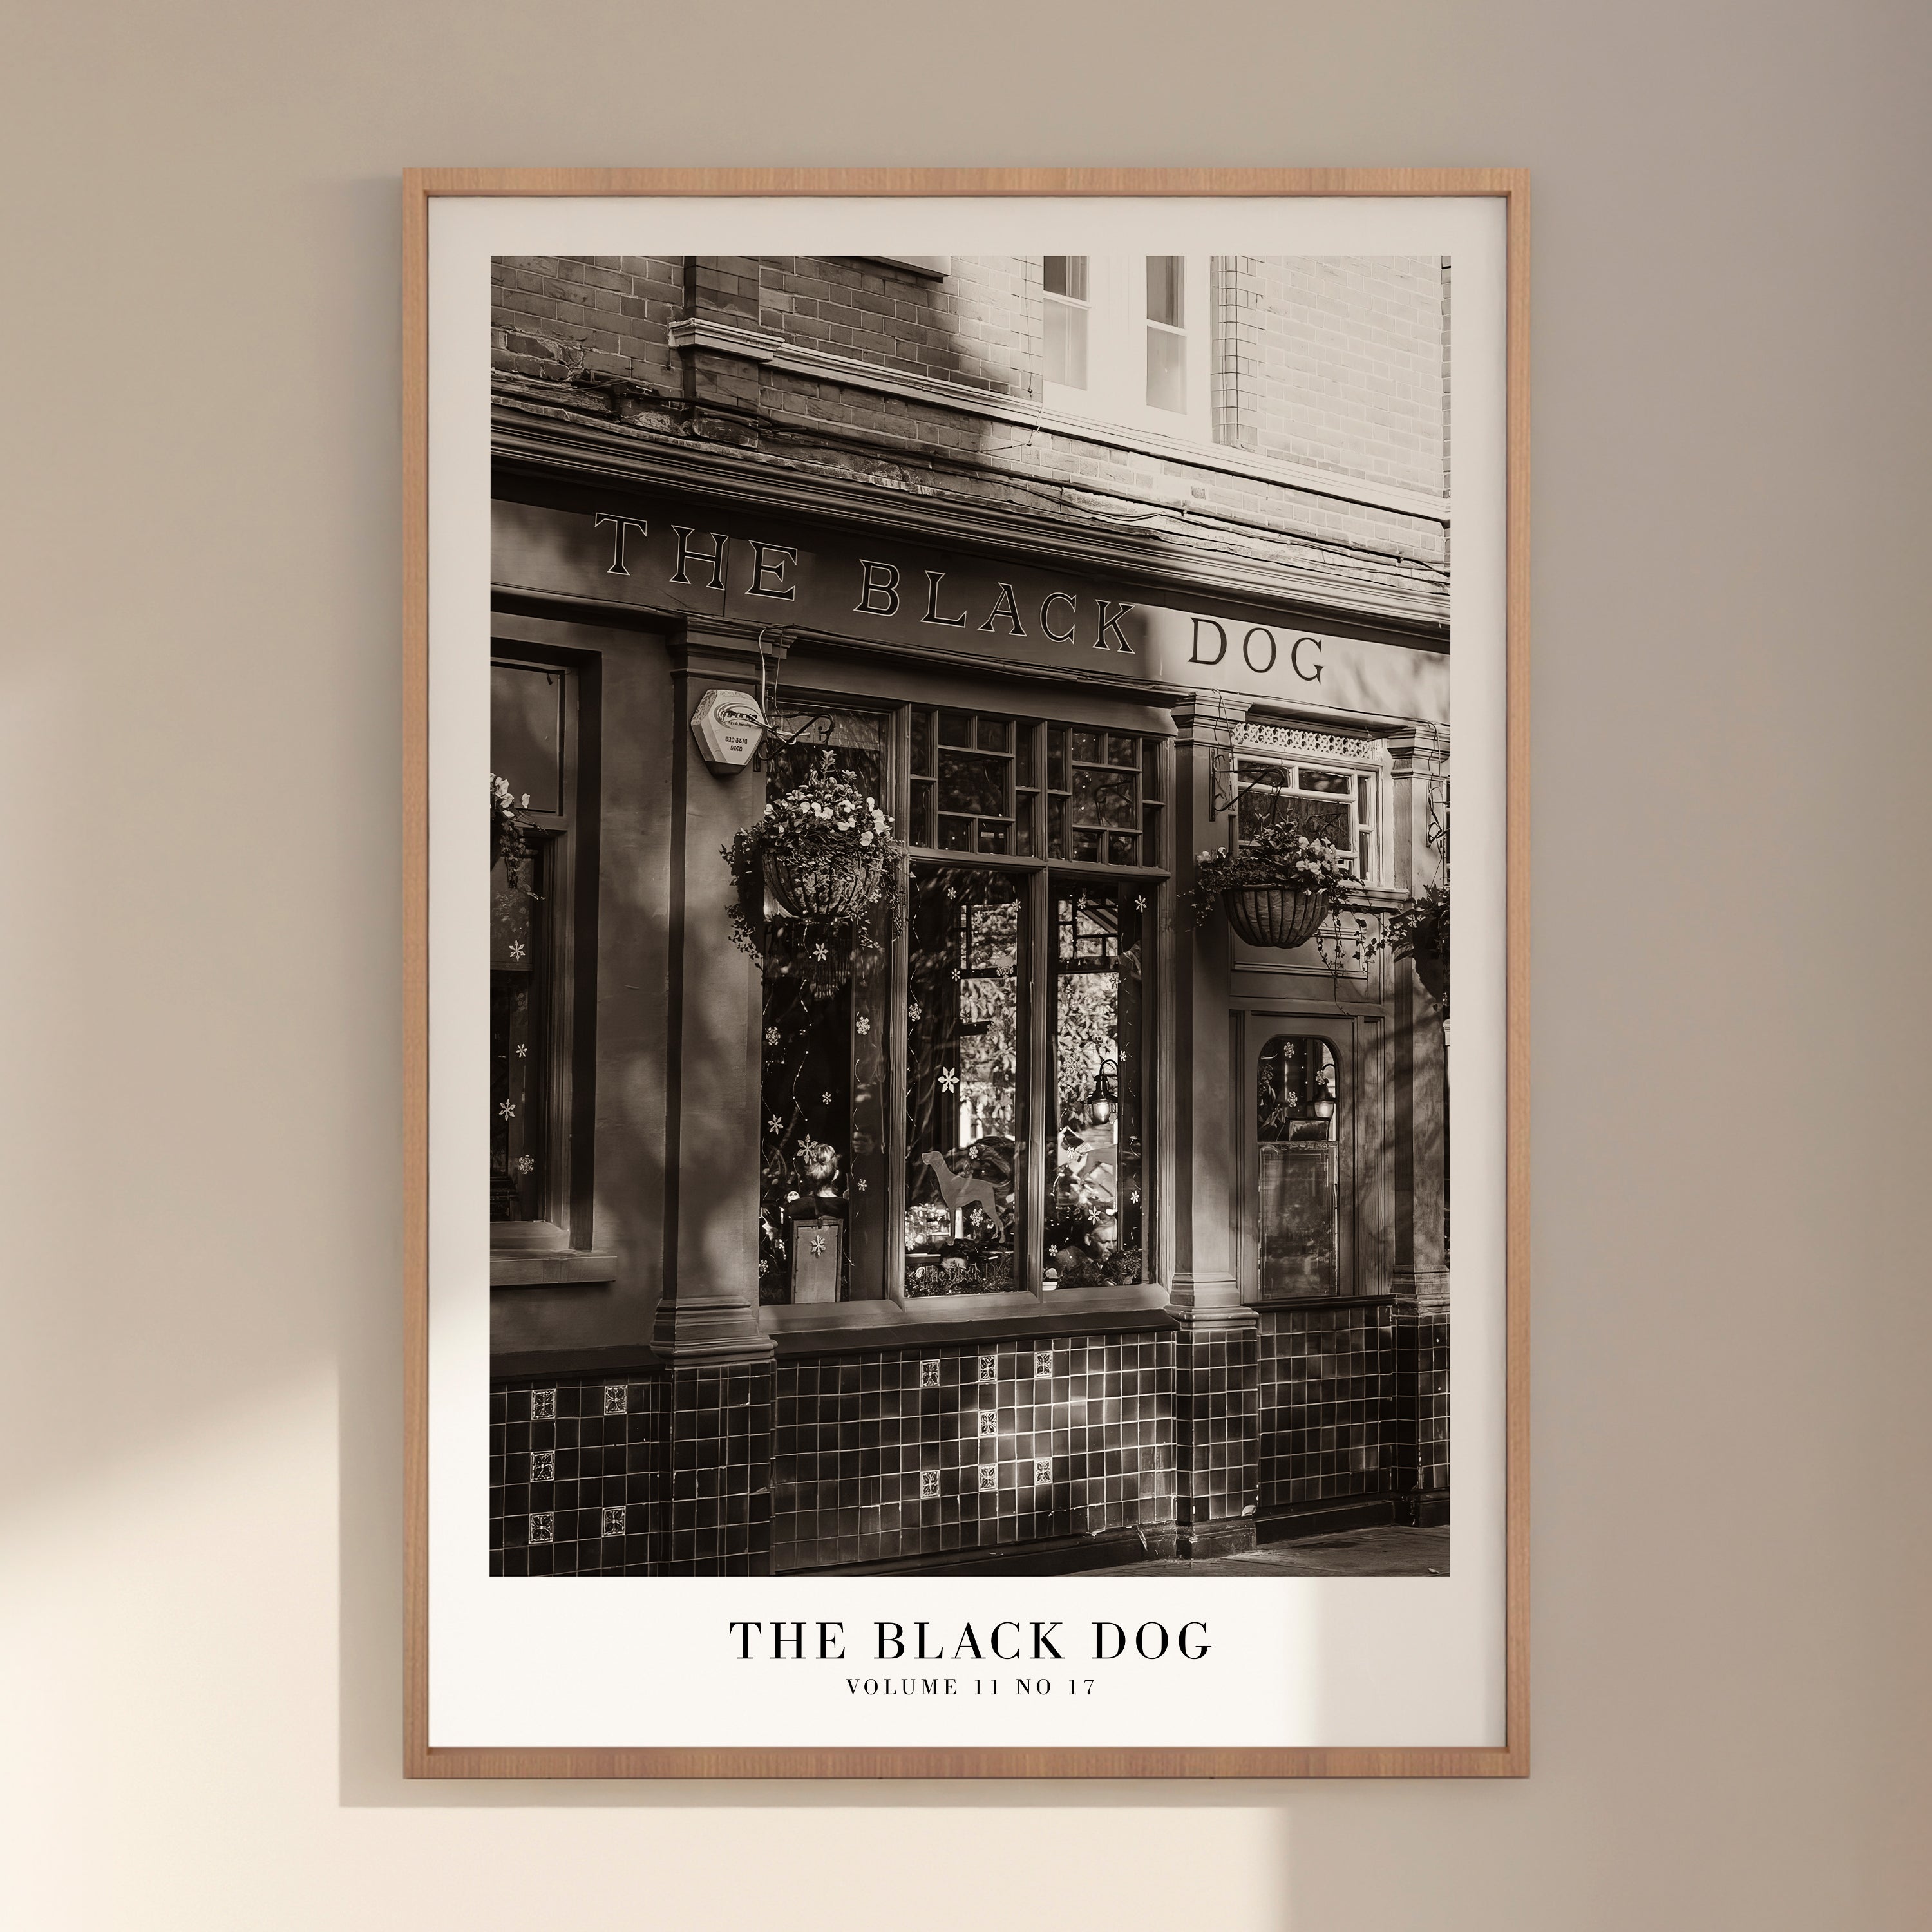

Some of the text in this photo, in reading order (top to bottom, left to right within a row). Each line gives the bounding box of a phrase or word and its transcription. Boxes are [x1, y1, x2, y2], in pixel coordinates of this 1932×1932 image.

[594, 512, 1324, 685] THE BLACK DOG
[730, 1622, 1212, 1660] THE BLACK DOG
[846, 1678, 1095, 1695] VOLUME 11 NO 17
